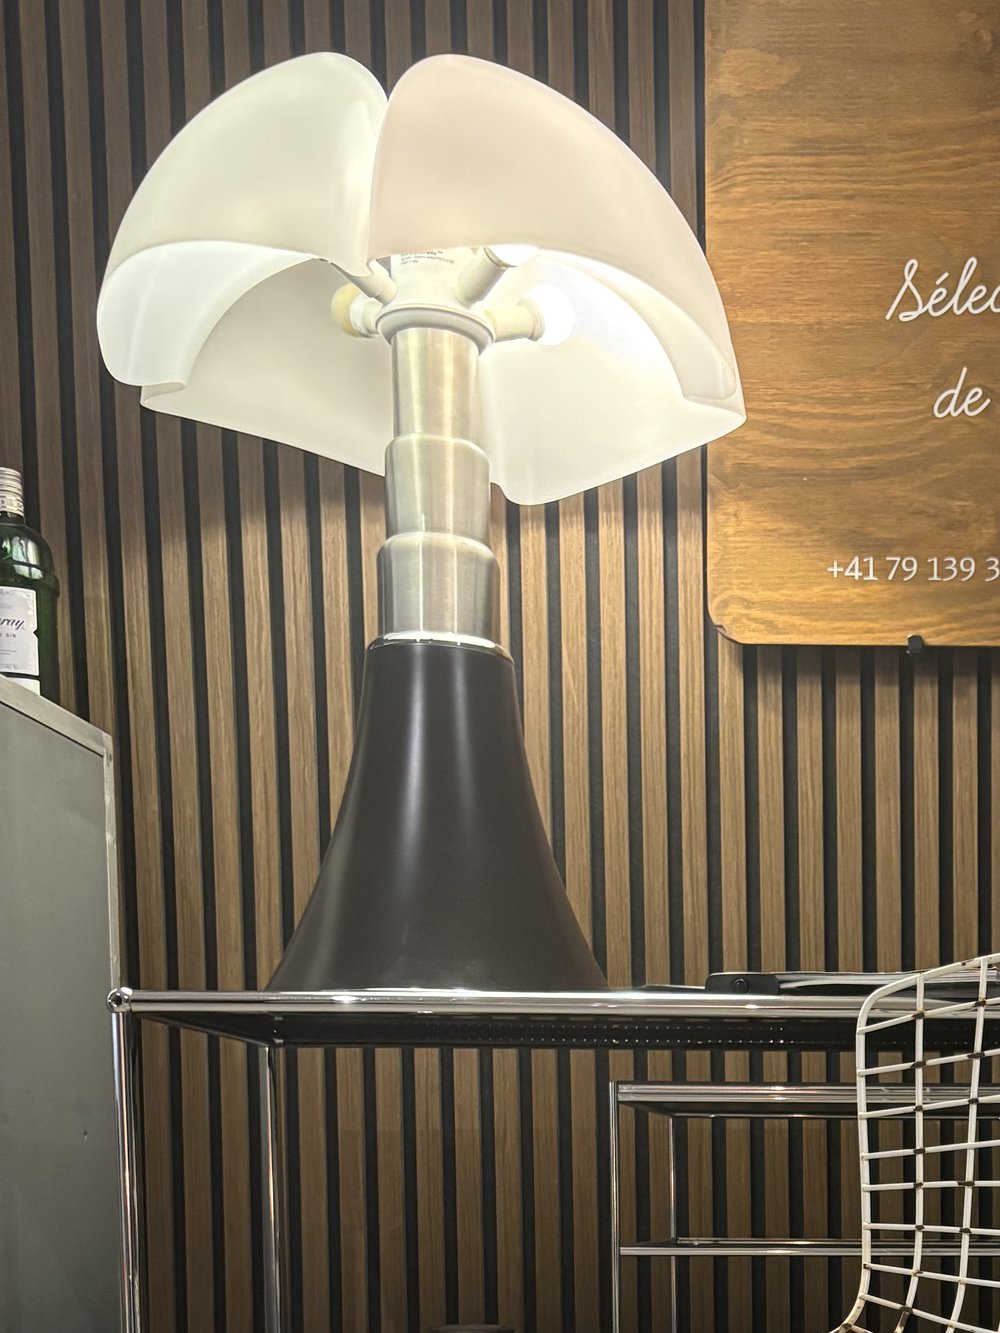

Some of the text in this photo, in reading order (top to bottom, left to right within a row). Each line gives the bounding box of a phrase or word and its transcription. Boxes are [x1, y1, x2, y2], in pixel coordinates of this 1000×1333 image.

[933, 366, 991, 419] de
[827, 556, 879, 581] +41
[885, 556, 918, 582] 79
[927, 556, 976, 582] 139
